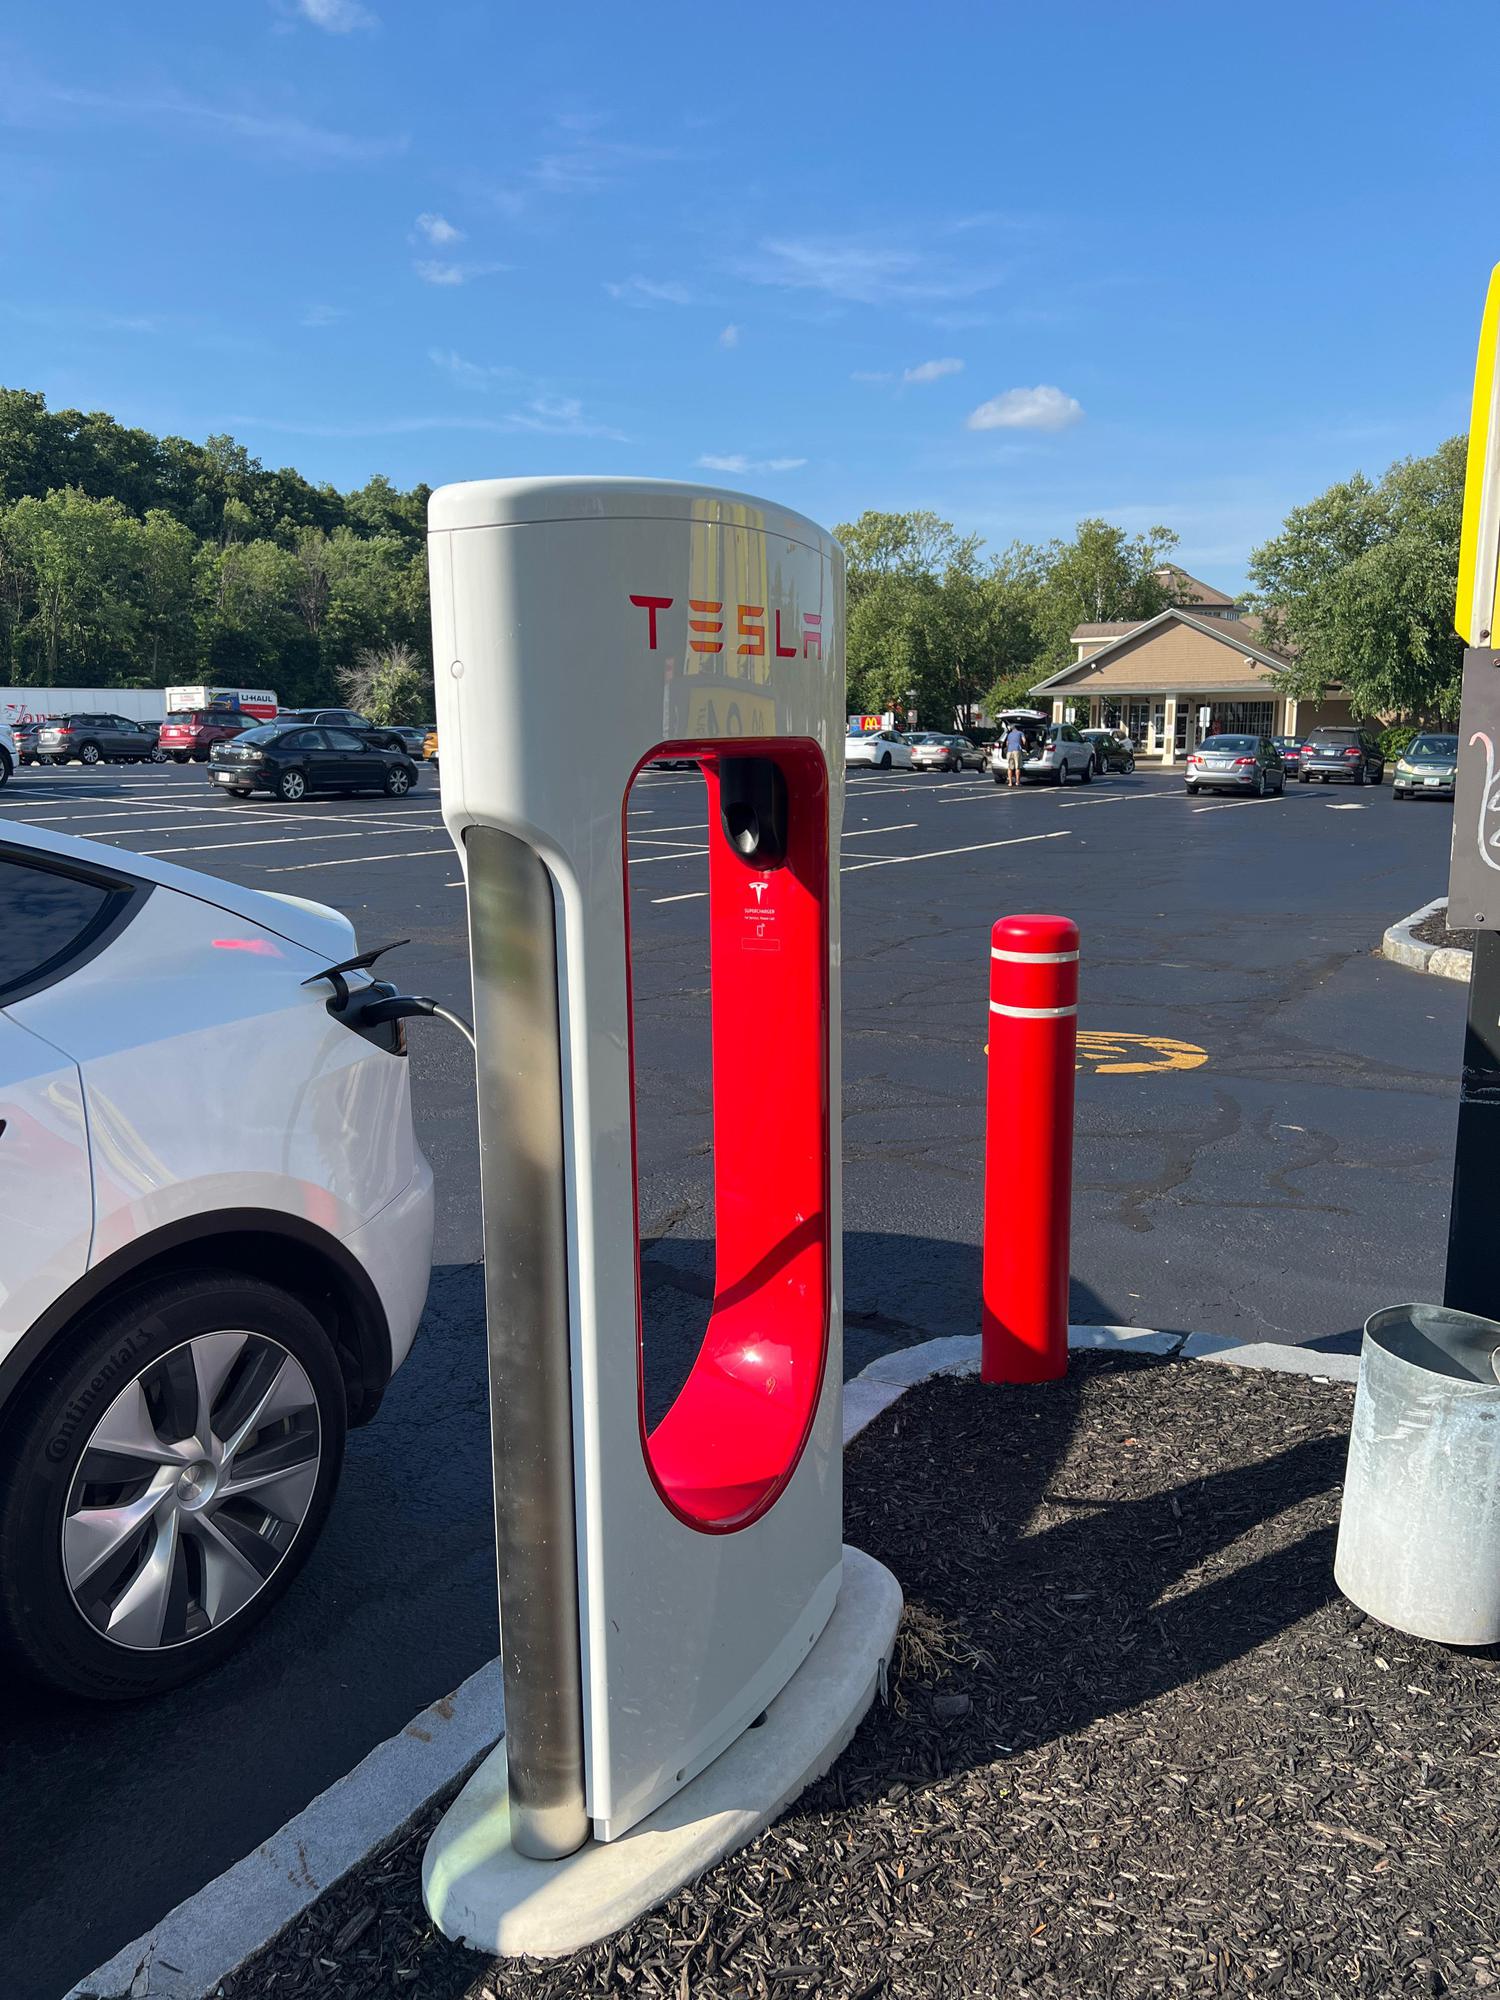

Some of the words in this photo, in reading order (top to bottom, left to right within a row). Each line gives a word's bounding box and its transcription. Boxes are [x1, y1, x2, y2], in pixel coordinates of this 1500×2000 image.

[629, 595, 822, 660] TESLA
[241, 694, 273, 702] U-HAUL
[46, 1331, 140, 1463] Continental
